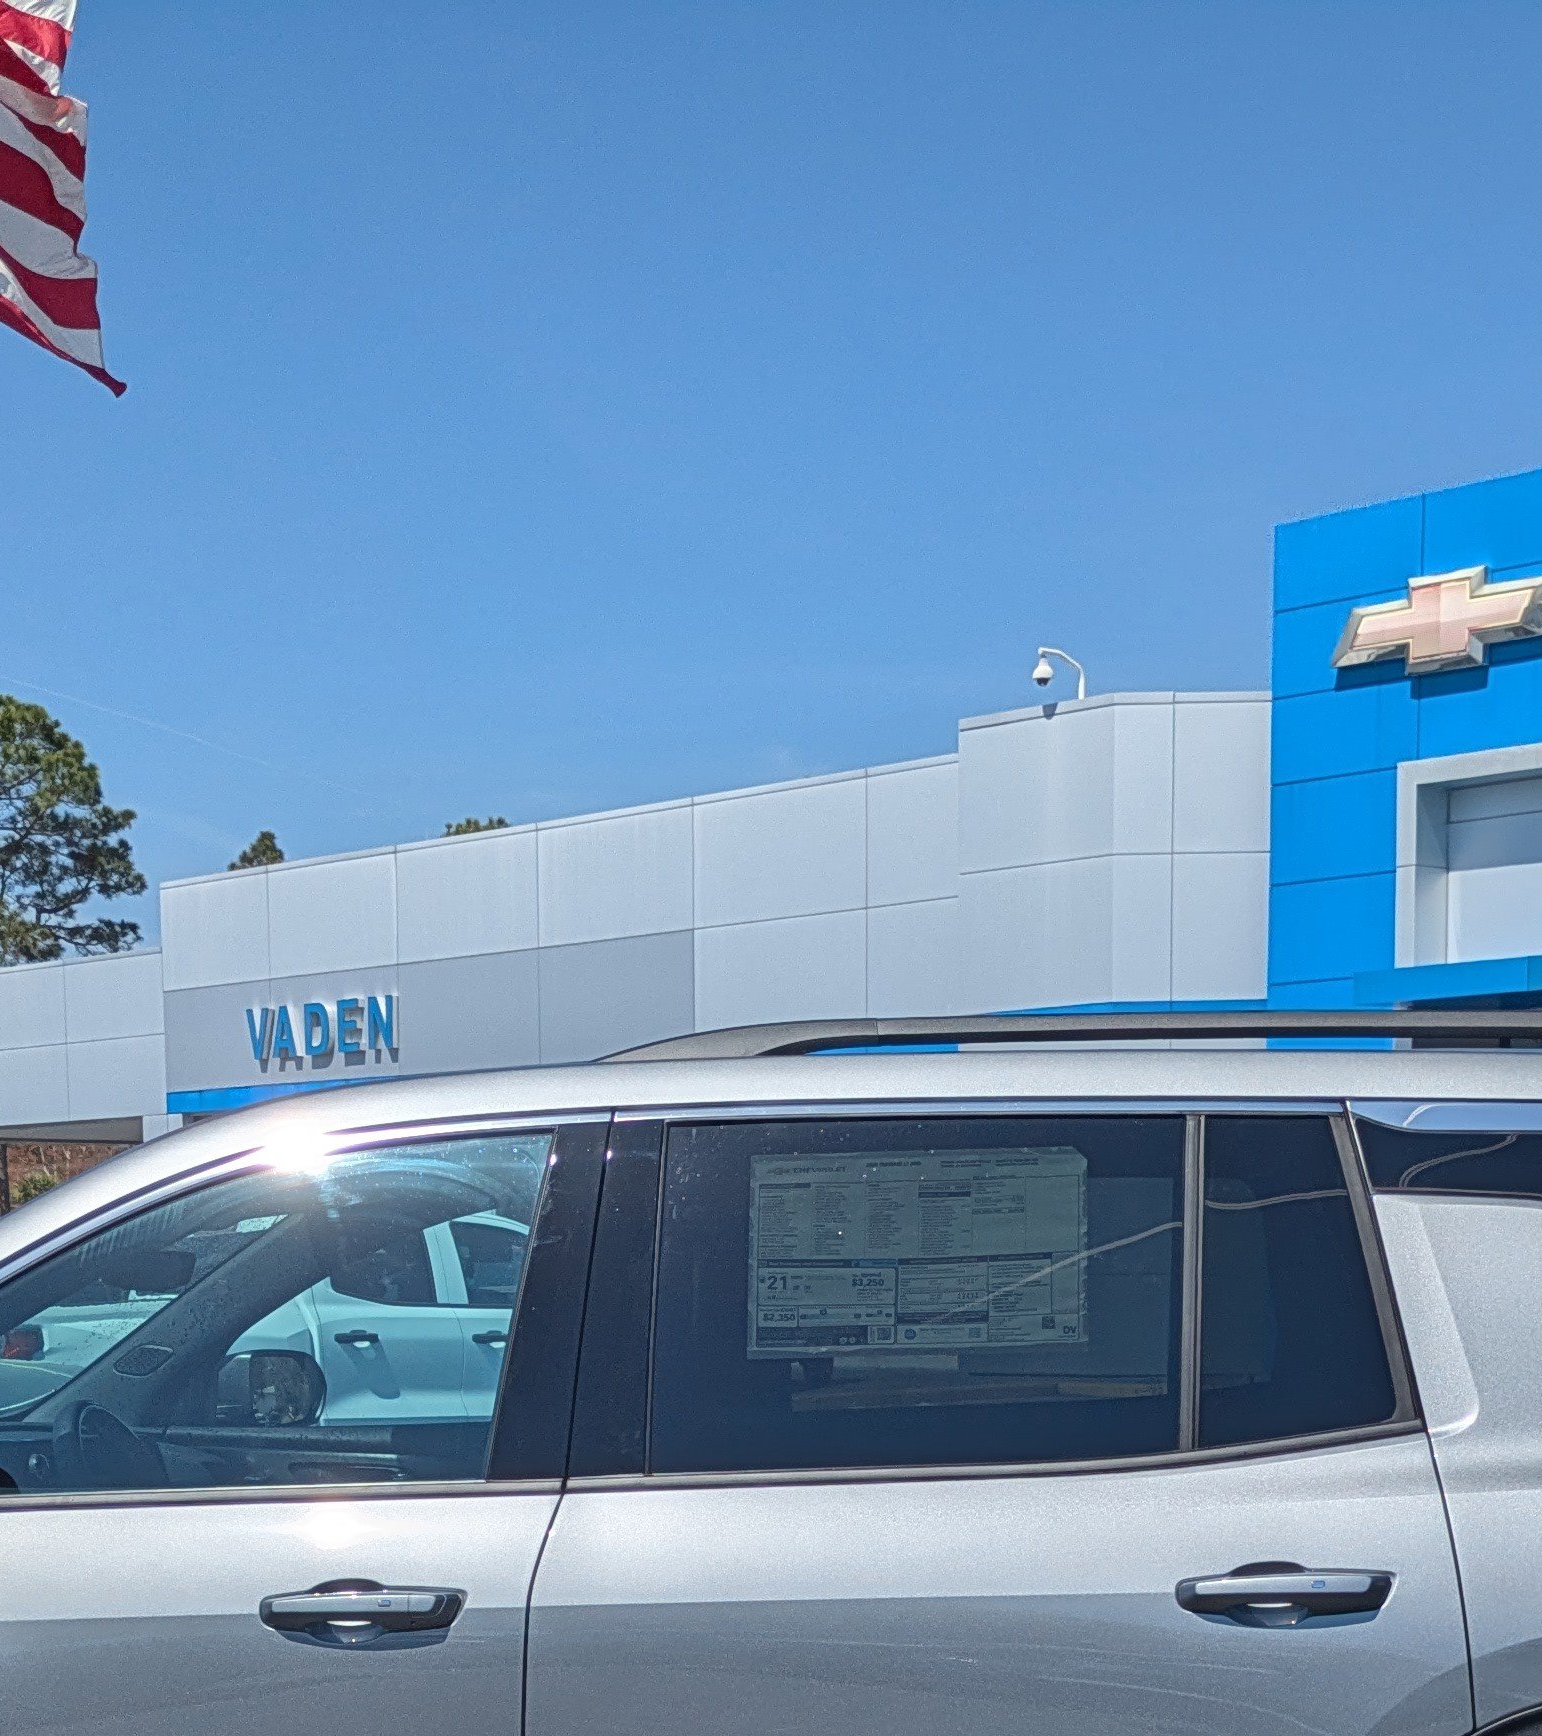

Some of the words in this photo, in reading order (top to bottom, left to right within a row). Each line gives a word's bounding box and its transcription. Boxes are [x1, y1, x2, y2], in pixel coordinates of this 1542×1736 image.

[246, 994, 397, 1061] VADEN
[767, 1275, 787, 1291] 21
[851, 1278, 885, 1288] $3,250
